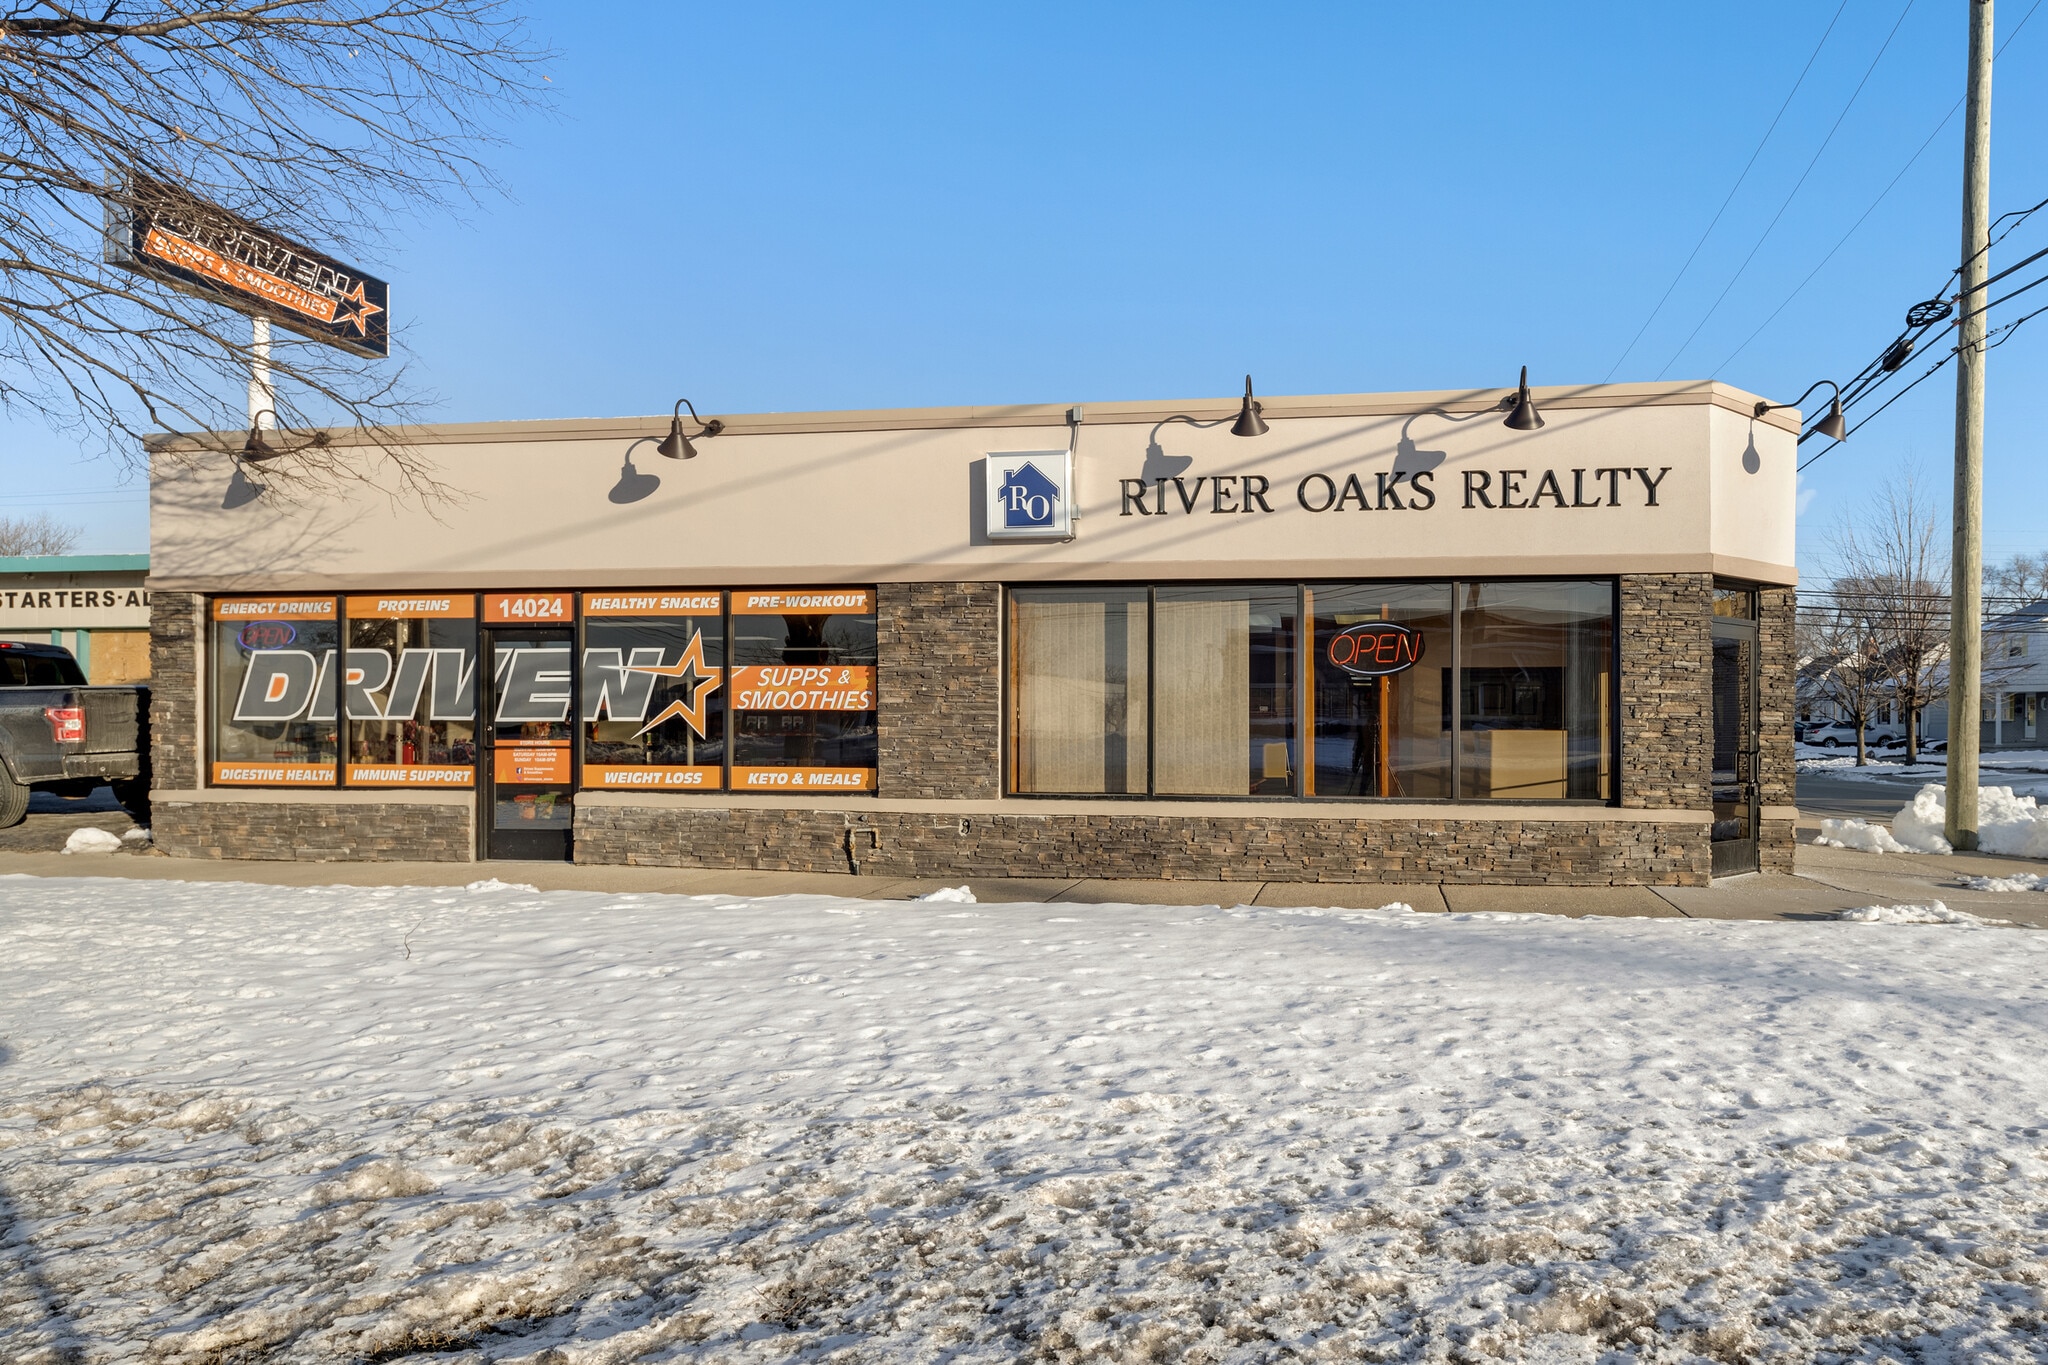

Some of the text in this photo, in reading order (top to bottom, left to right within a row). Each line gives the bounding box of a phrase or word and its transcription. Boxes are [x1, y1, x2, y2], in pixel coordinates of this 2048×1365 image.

[153, 236, 330, 316] SUPPS & SMOOTHIES
[1119, 467, 1672, 516] RIVER OAKS REALTY
[220, 601, 332, 615] ENERGY DRINKS
[377, 600, 451, 612] PROTEINS
[499, 598, 564, 618] 14024
[590, 596, 720, 610] HEALTHY SNACKS
[747, 594, 867, 608] PRE-WORKOUT
[241, 626, 292, 645] OPEN
[1330, 633, 1421, 665] OPEN
[233, 647, 666, 722] DRIVEN
[757, 667, 851, 687] SUPPS &
[736, 690, 873, 710] SMOOTHIES
[220, 768, 335, 782] DIGESTIVE HEALTH
[353, 769, 472, 783] IMMUNE SUPPORT
[604, 771, 703, 784] WEIGHT LOSS
[747, 772, 862, 786] KETO & MEALS
